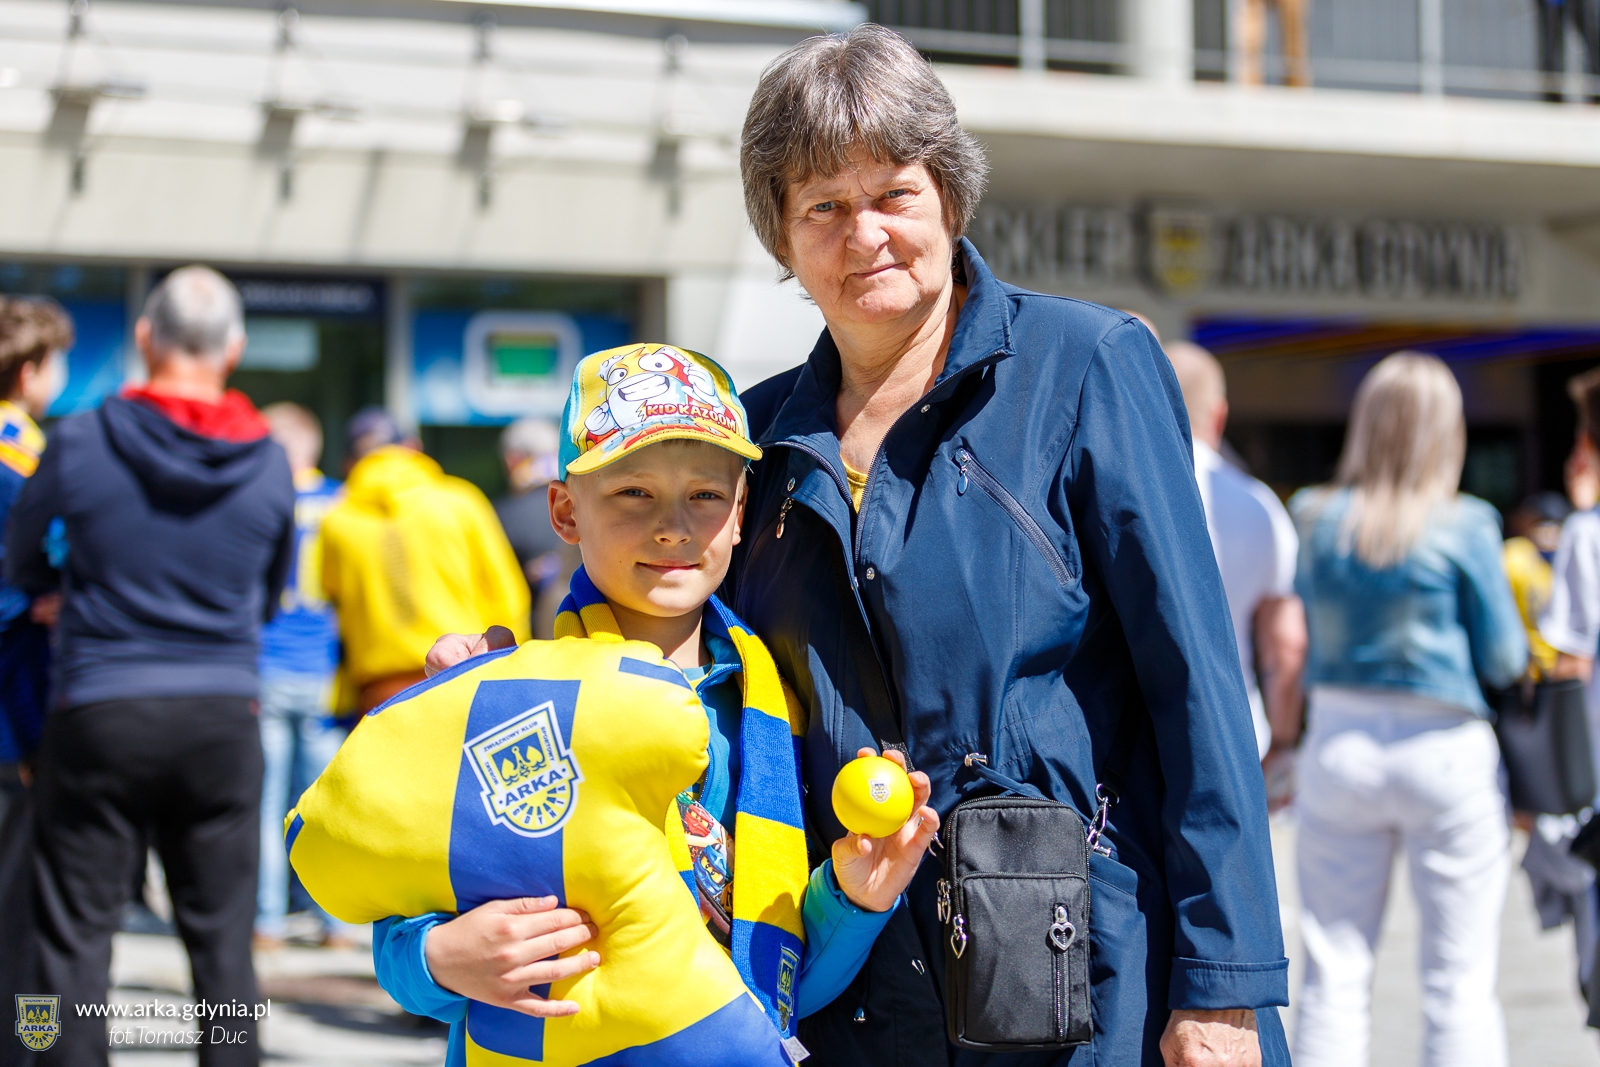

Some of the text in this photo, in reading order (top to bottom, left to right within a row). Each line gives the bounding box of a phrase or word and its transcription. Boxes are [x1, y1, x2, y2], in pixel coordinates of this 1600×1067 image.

[646, 404, 738, 434] KID KAZOOM
[506, 770, 564, 807] ARKA
[512, 785, 567, 825] GDYNIA
